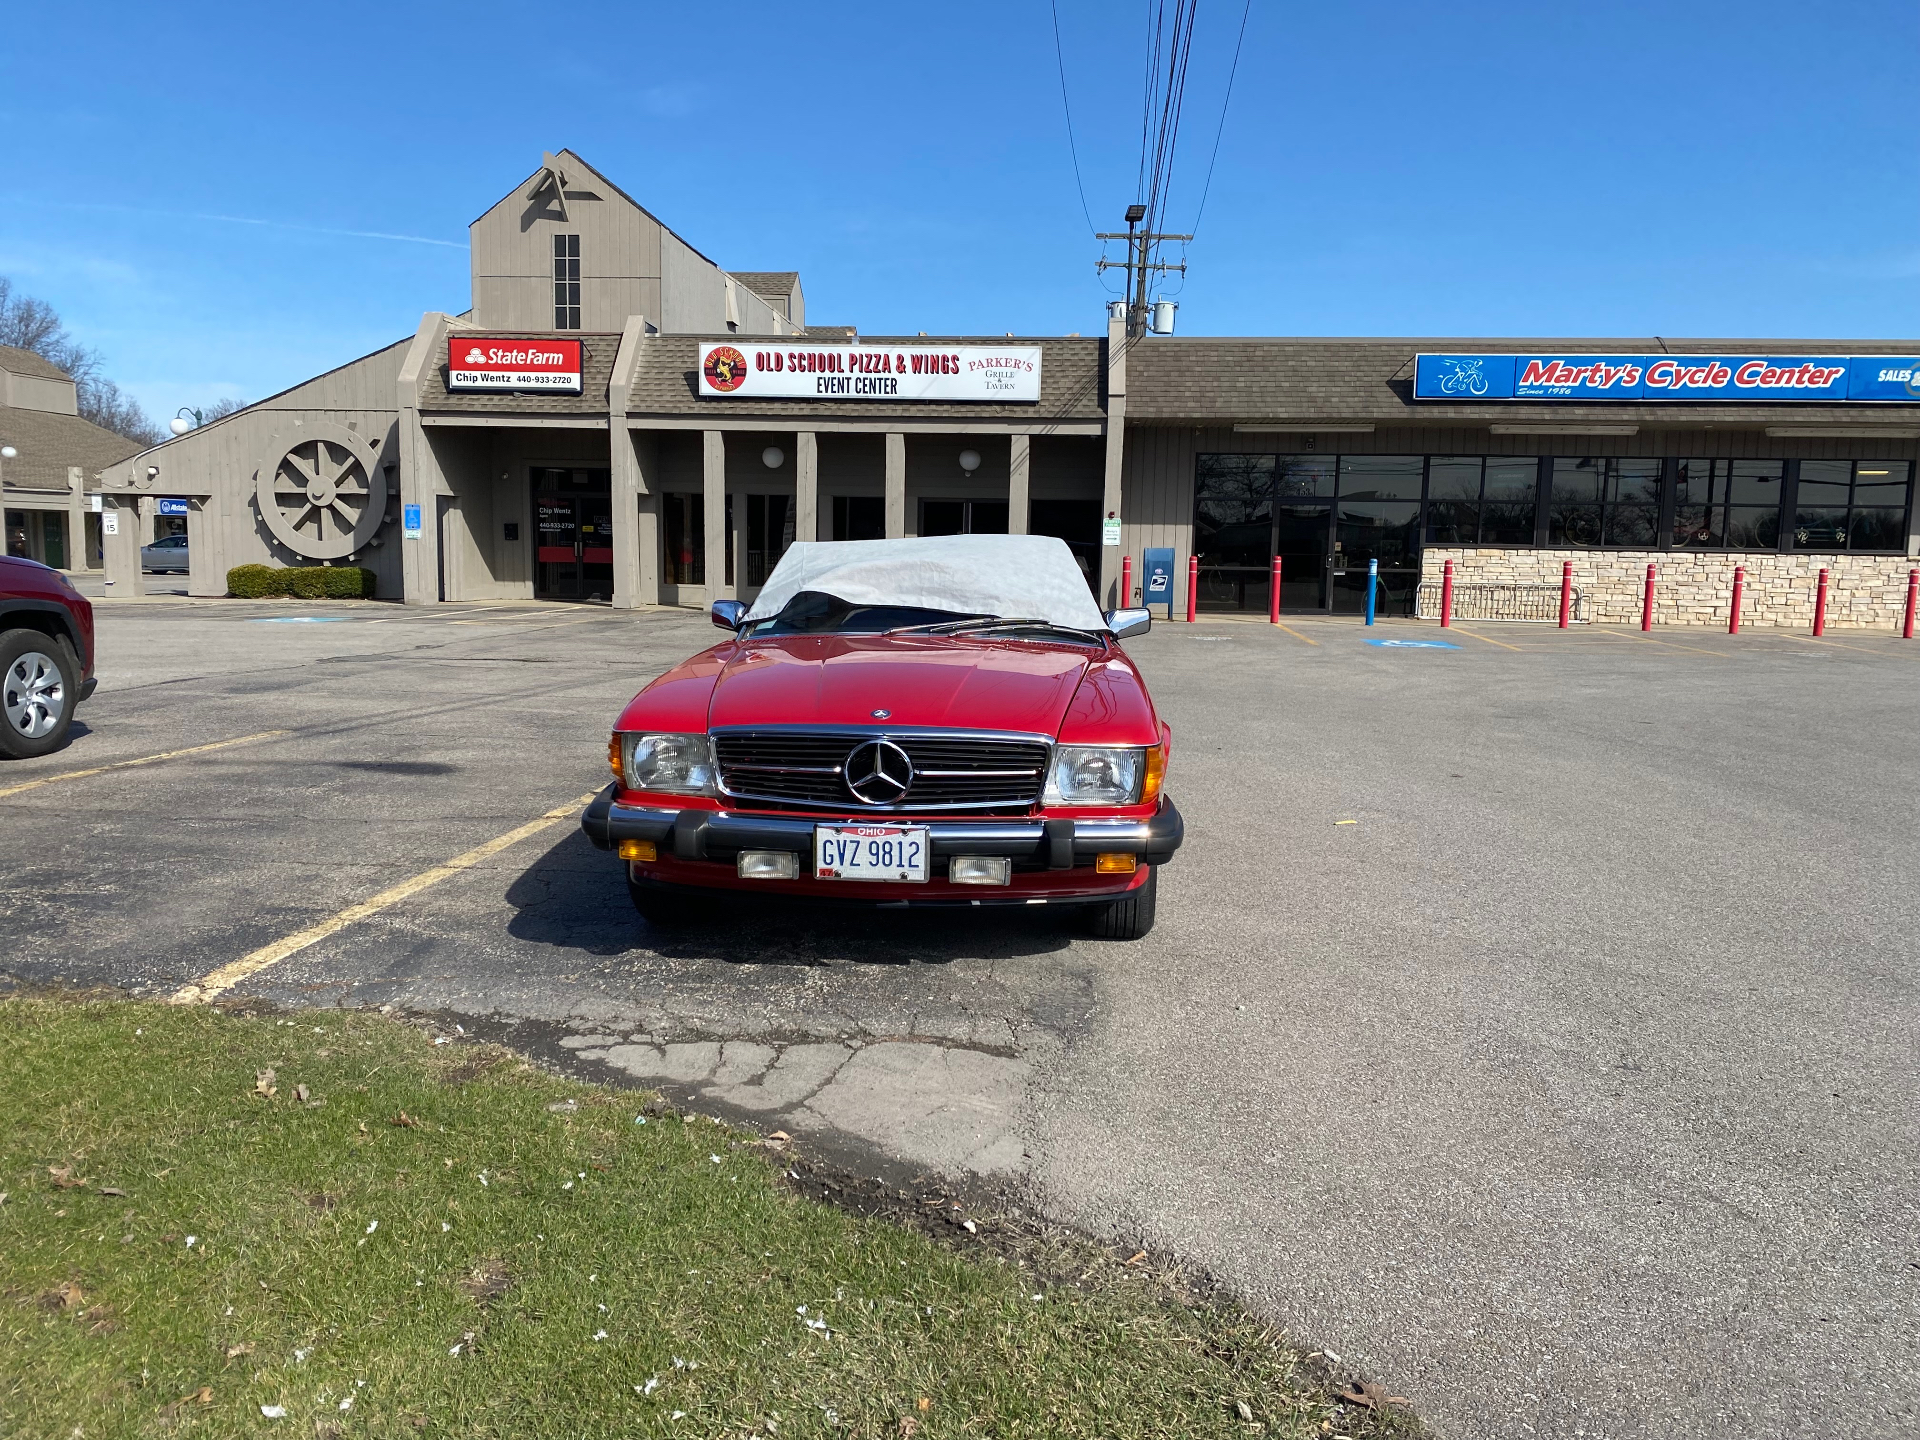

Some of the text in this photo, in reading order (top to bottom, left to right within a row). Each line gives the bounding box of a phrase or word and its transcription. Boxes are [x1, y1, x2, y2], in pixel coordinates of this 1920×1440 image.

[488, 348, 564, 365] State Farm
[756, 351, 960, 374] OLD SCHOOL PIZZA & WINGS
[967, 357, 1034, 373] PARKER'S
[456, 373, 572, 384] Chip Wentz 440-933-2720
[1519, 360, 1846, 389] Marty's Cycle Center
[1878, 369, 1912, 382] SALES
[816, 377, 898, 395] EVENT CENTER
[1517, 387, 1571, 395] Since 1986
[106, 524, 116, 532] 15
[857, 827, 886, 836] OHIO
[823, 839, 920, 868] GVZ 9812
